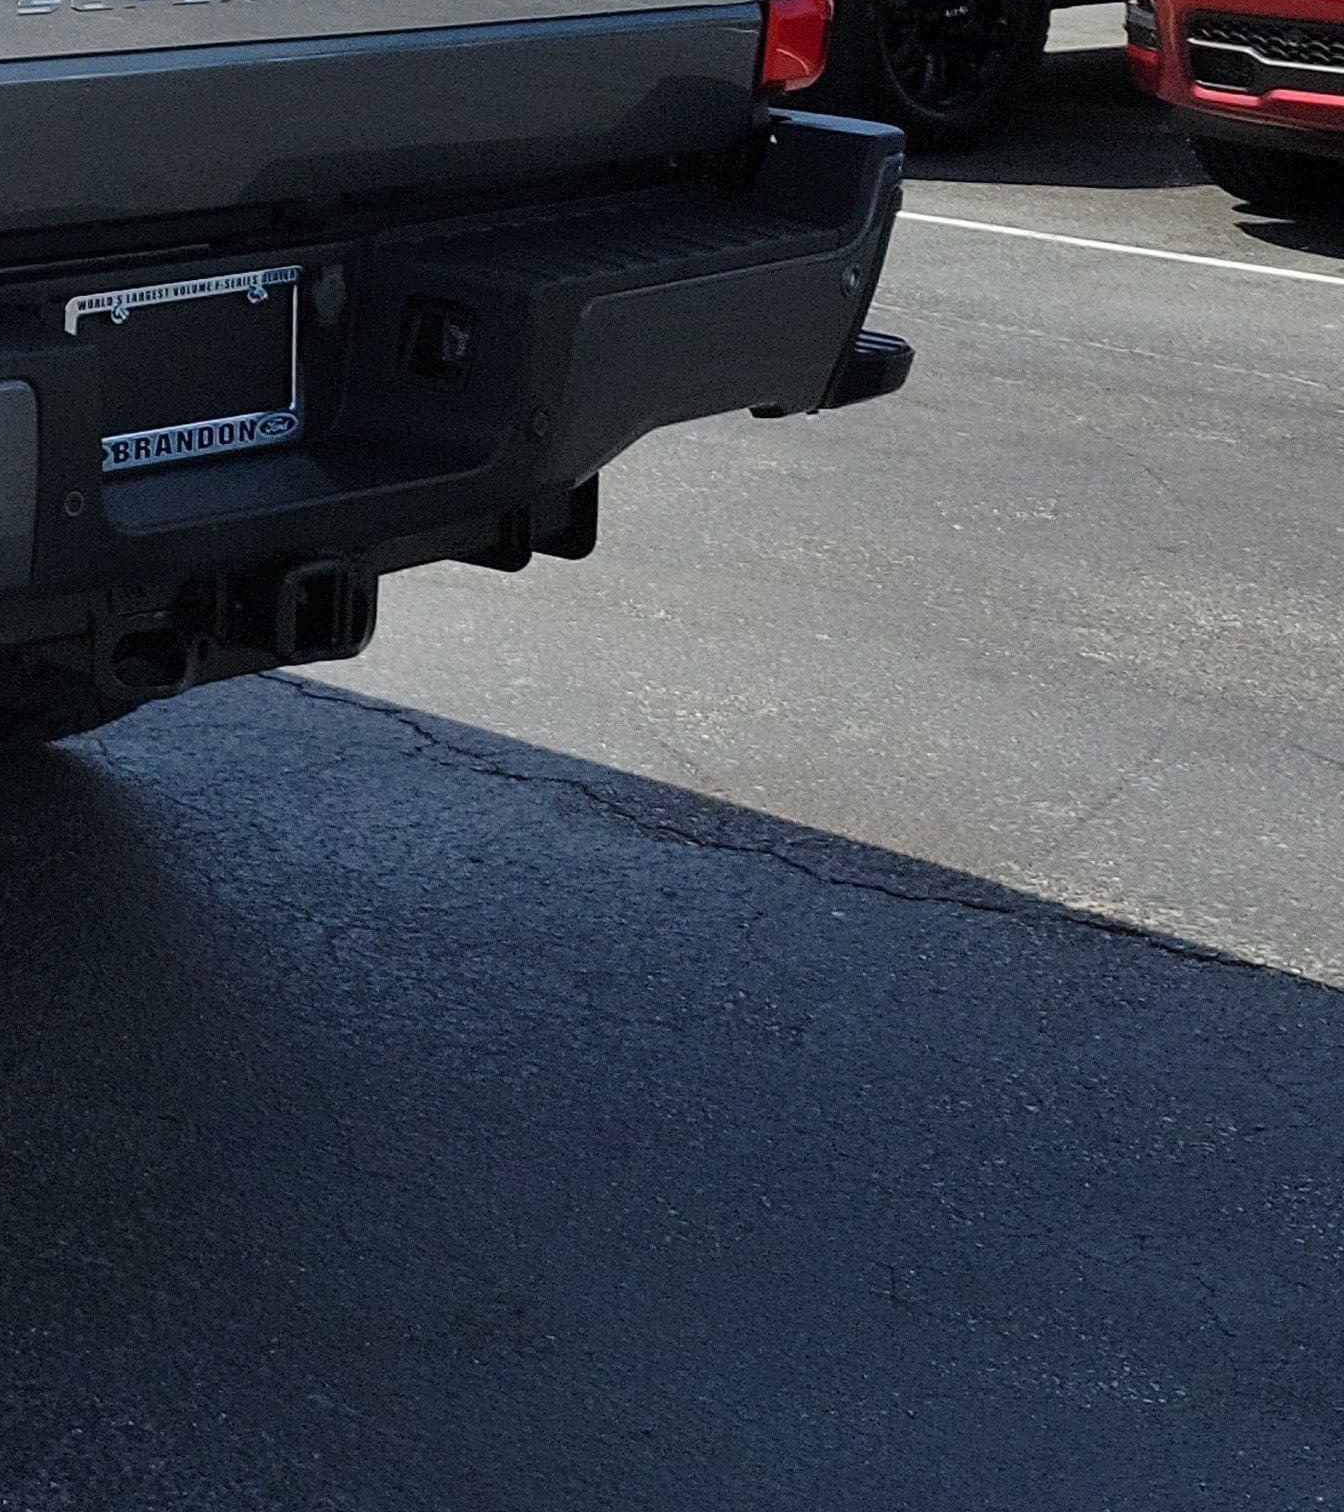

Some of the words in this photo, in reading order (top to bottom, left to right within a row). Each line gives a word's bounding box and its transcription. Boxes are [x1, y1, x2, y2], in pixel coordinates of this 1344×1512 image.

[125, 287, 170, 304] LARGEST
[172, 279, 212, 297] VOLUME
[214, 273, 259, 292] F-SERIES
[111, 419, 258, 464] BRANDON
